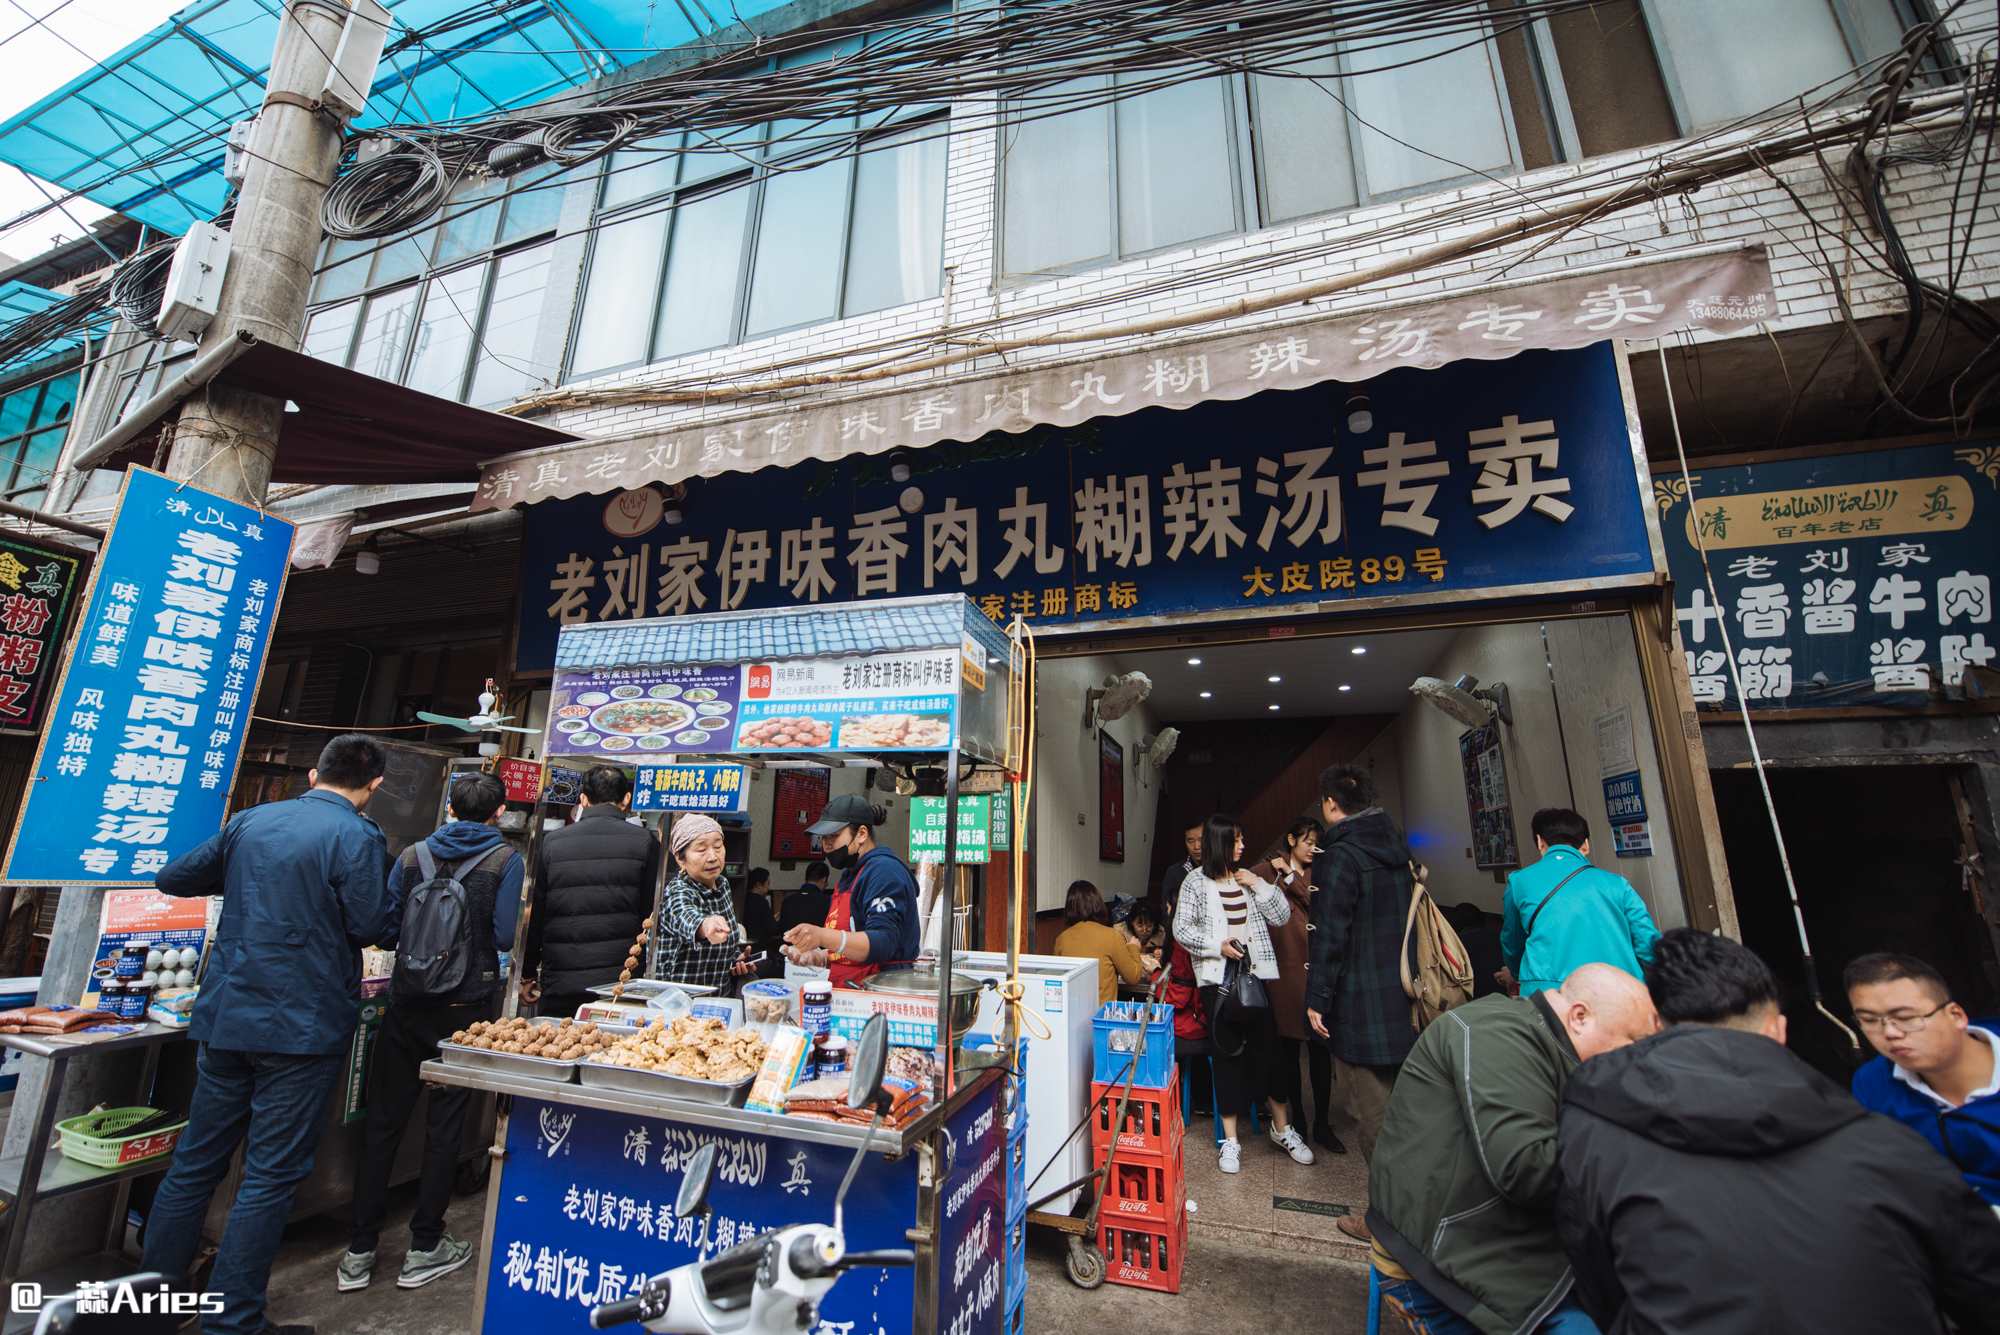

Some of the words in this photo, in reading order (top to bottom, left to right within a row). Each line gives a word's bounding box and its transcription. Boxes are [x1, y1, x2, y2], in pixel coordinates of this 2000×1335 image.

[1688, 304, 1767, 320] 13488064495
[165, 497, 192, 516] 清
[547, 414, 1575, 623] 老刘家伊味香肉丸糊辣汤专卖
[1919, 484, 1957, 522] 真
[242, 523, 264, 541] 真
[1700, 506, 1732, 540] 清
[1772, 517, 1884, 538] 百年老店
[1242, 547, 1449, 599] 大皮院89号
[1727, 542, 1931, 579] 老刘家
[970, 581, 1138, 621] 家注册商标
[1675, 570, 1992, 643] 十香酱牛肉
[89, 581, 140, 668] 味道鲜美
[95, 529, 243, 845] 老刘家伊味香肉丸糊辣汤
[199, 578, 270, 791] 老刘家商标注册叫伊味香
[776, 667, 815, 681] 网易新闻
[842, 657, 954, 690] 老刘家注册商标叫伊味香
[56, 687, 105, 778] 风味独特
[502, 770, 524, 780] 大碗
[503, 779, 522, 789] 小碗
[510, 763, 537, 773] 价目表
[655, 769, 741, 792] 香酥牛肉丸子、小酥肉
[659, 794, 730, 808] 干吃或烩汤最好
[993, 797, 1007, 844] 小心滑倒
[79, 847, 169, 876] 专卖
[126, 1151, 142, 1161] THE
[144, 1142, 174, 1156] SPOON
[127, 1130, 178, 1151] 勺子
[624, 1125, 652, 1167] 清
[780, 1150, 812, 1196] 真
[562, 1183, 777, 1253] 老刘家伊味香肉丸糊辣
[1118, 1200, 1149, 1213] 可口可乐
[953, 1206, 991, 1294] 秘制优质
[1118, 1267, 1149, 1281] 可口可乐
[943, 1289, 975, 1335] 肉丸子
